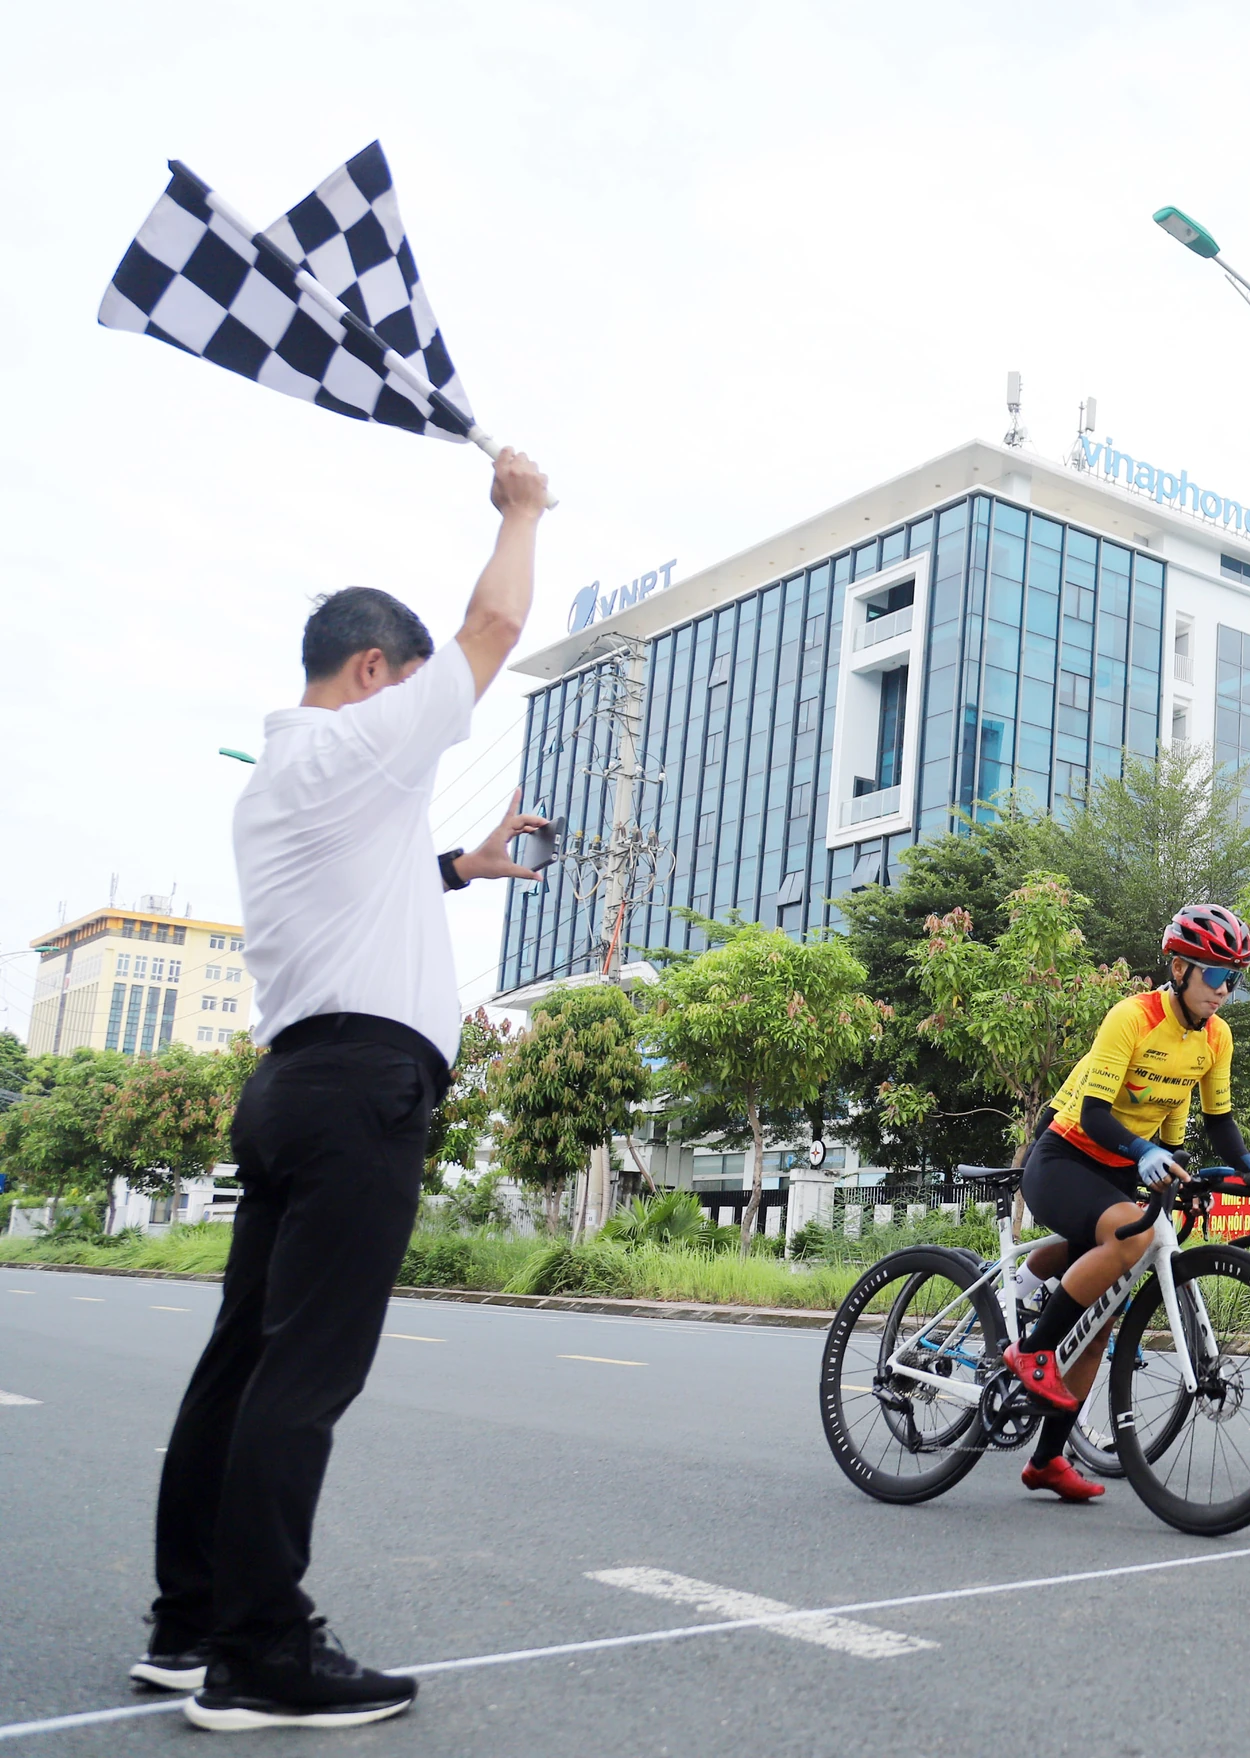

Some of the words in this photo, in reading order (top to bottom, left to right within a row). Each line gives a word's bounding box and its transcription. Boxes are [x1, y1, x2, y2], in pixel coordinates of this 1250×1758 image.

[600, 558, 677, 620] VNPT
[1091, 1067, 1121, 1081] SUUNTO
[1134, 1067, 1149, 1078] HO
[1148, 1072, 1163, 1083] CHI
[1162, 1075, 1182, 1086] MINH
[1228, 1211, 1242, 1235] HỘI
[826, 1320, 848, 1382] LIMITED
[848, 1269, 890, 1313] EDITION
